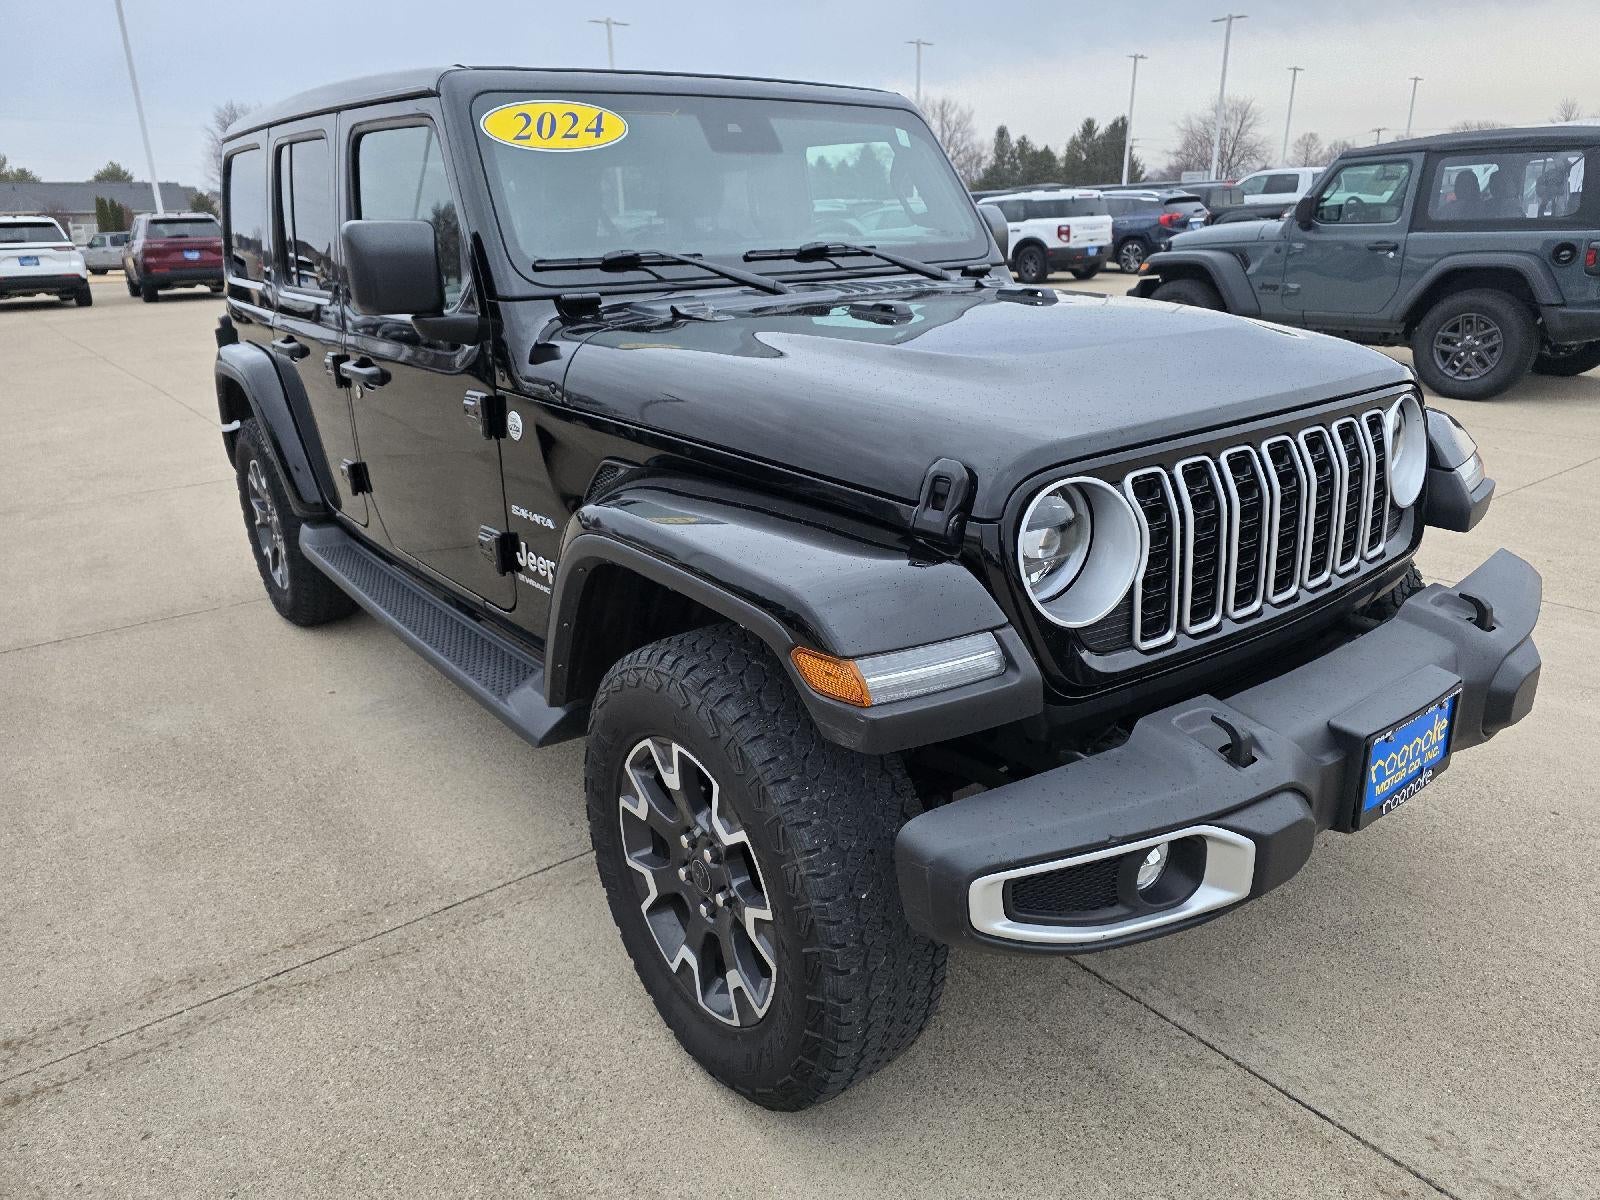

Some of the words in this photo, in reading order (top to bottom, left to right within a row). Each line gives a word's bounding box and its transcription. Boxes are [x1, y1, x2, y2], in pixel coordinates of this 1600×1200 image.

[512, 111, 604, 140] 2024
[511, 504, 555, 529] SAHARA
[516, 541, 556, 584] Jeep
[1375, 768, 1407, 796] MOTOR
